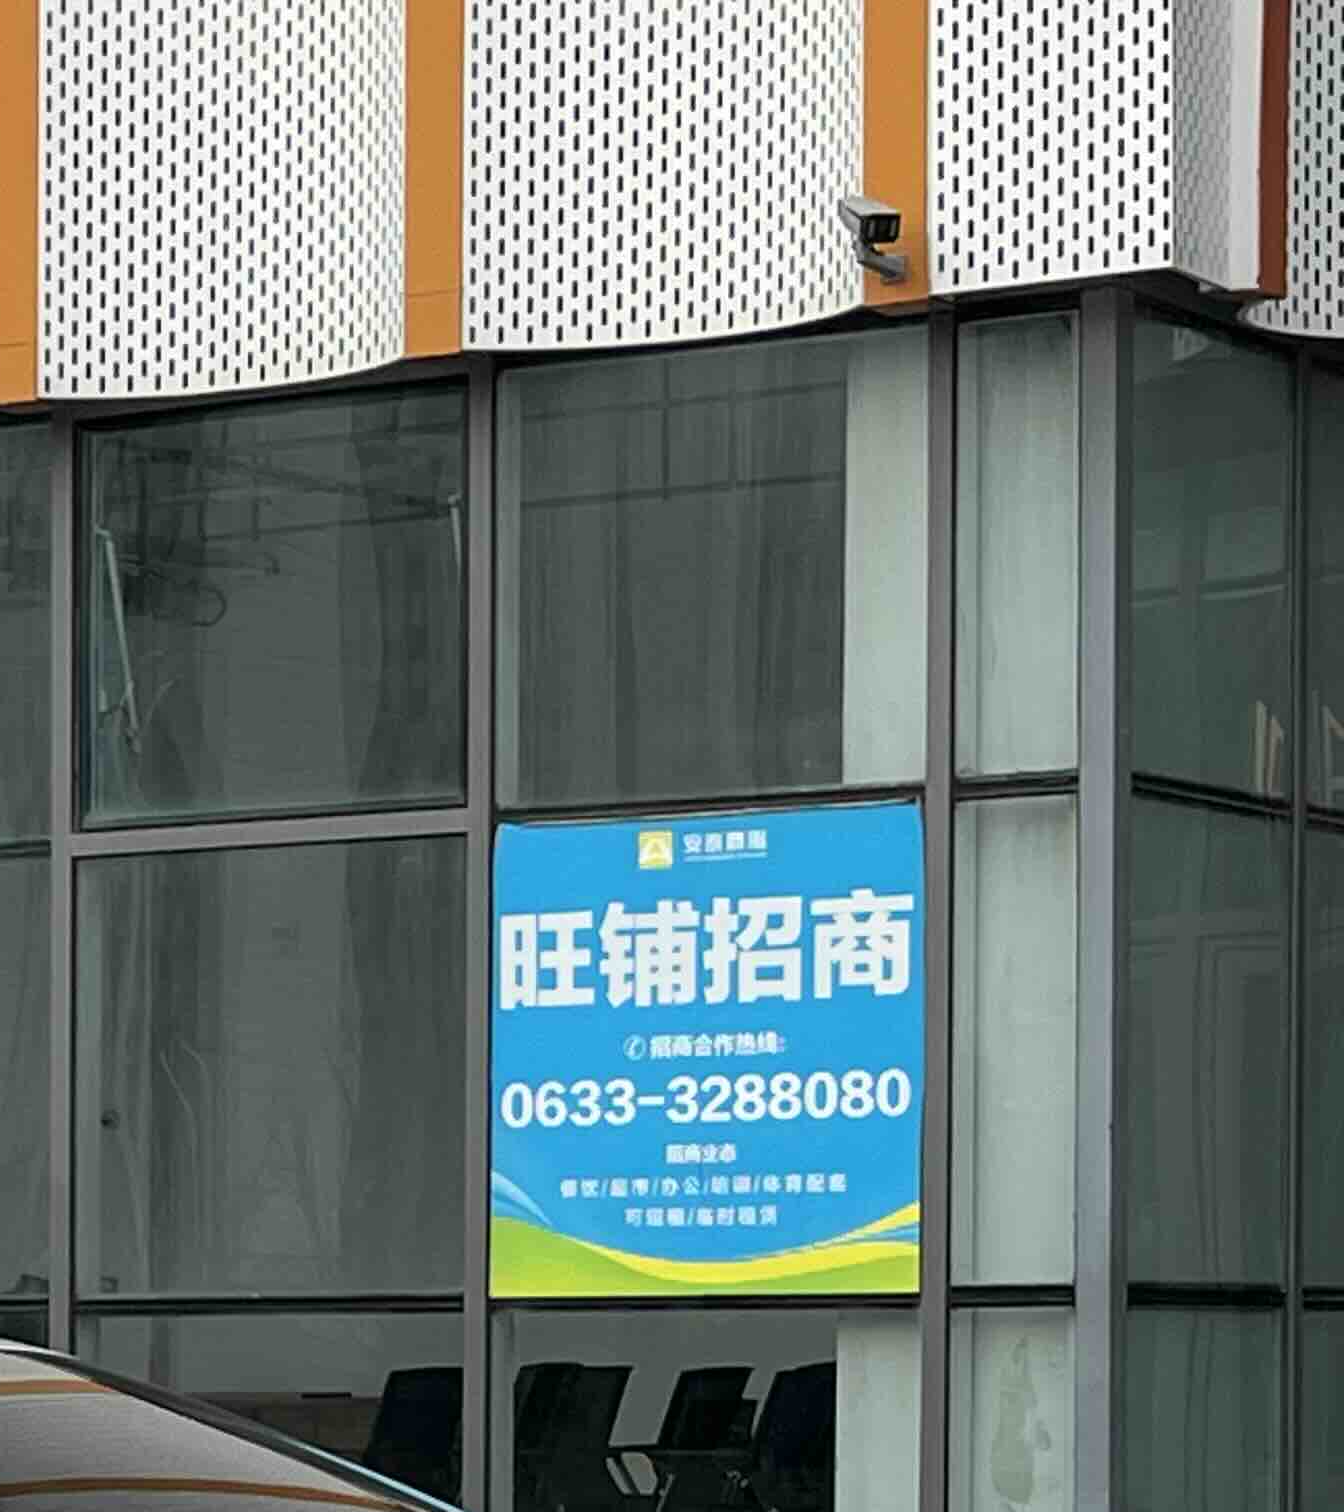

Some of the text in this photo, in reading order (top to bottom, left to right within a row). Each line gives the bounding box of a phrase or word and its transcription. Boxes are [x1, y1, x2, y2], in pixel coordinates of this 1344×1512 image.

[500, 888, 914, 1010] 旺铺招商
[500, 1068, 911, 1128] 0633-3288080
